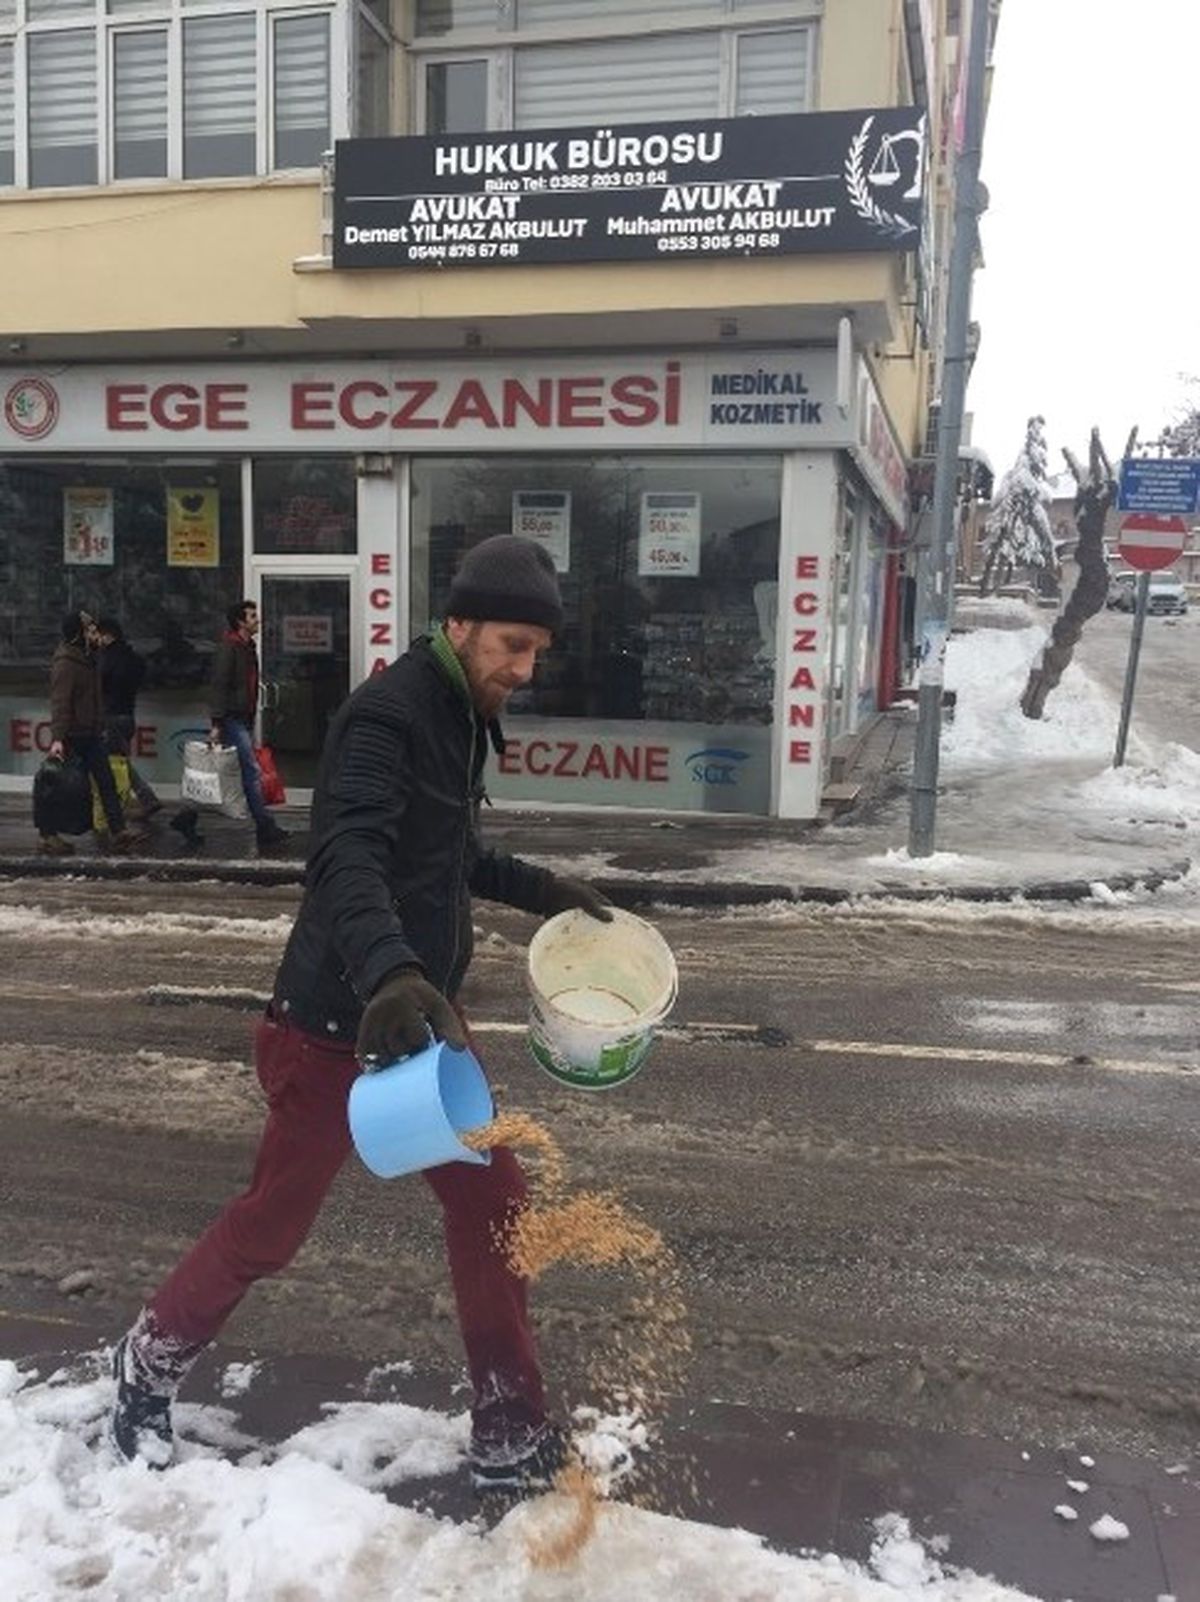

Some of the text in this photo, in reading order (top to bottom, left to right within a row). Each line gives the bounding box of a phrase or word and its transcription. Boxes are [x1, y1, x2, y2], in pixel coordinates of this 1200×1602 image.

[435, 130, 723, 175] HUKUK BÜROSU
[409, 196, 520, 222] AVUKAT
[660, 182, 783, 213] AVUKAT
[345, 218, 588, 244] Demet YILMAZ AKBULUT
[607, 207, 836, 236] Muhammet AKBULUT
[106, 362, 681, 431] EGE ECZANESİ
[711, 368, 808, 395] MEDİKAL
[710, 398, 822, 425] KOZMETİK
[369, 553, 392, 674] ECZA
[788, 556, 819, 765] ECZANE
[497, 739, 670, 782] ECZANE
